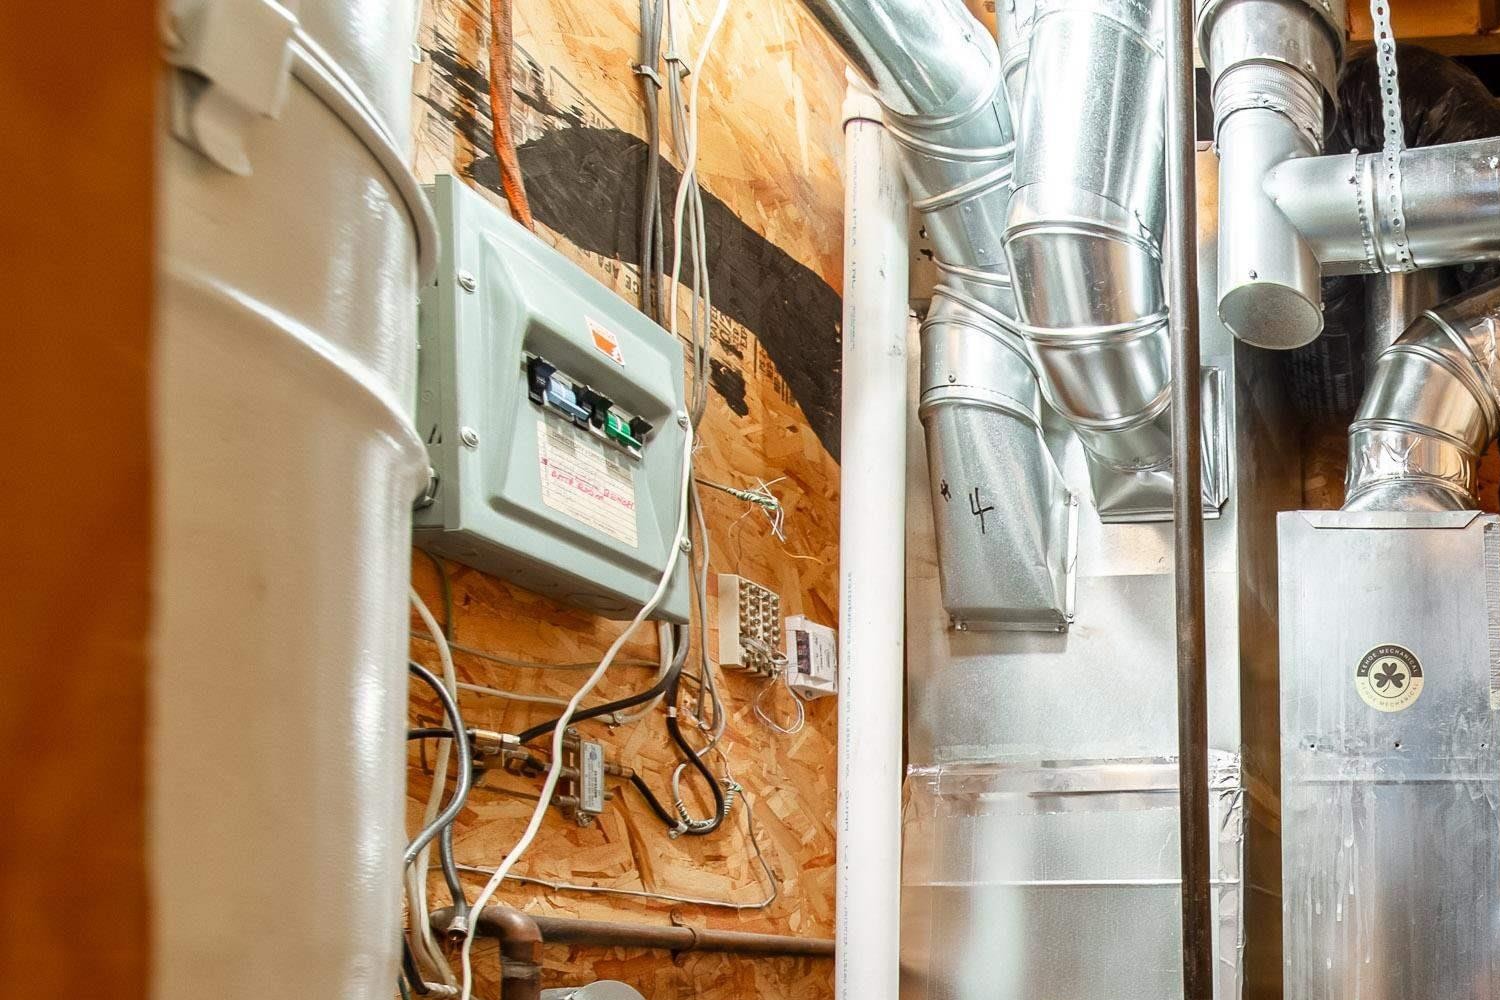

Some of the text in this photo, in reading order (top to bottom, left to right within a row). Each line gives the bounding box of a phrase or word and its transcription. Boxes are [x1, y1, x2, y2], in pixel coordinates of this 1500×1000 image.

[969, 487, 994, 534] 4
[1361, 648, 1418, 674] KEHOE MECHANICAL
